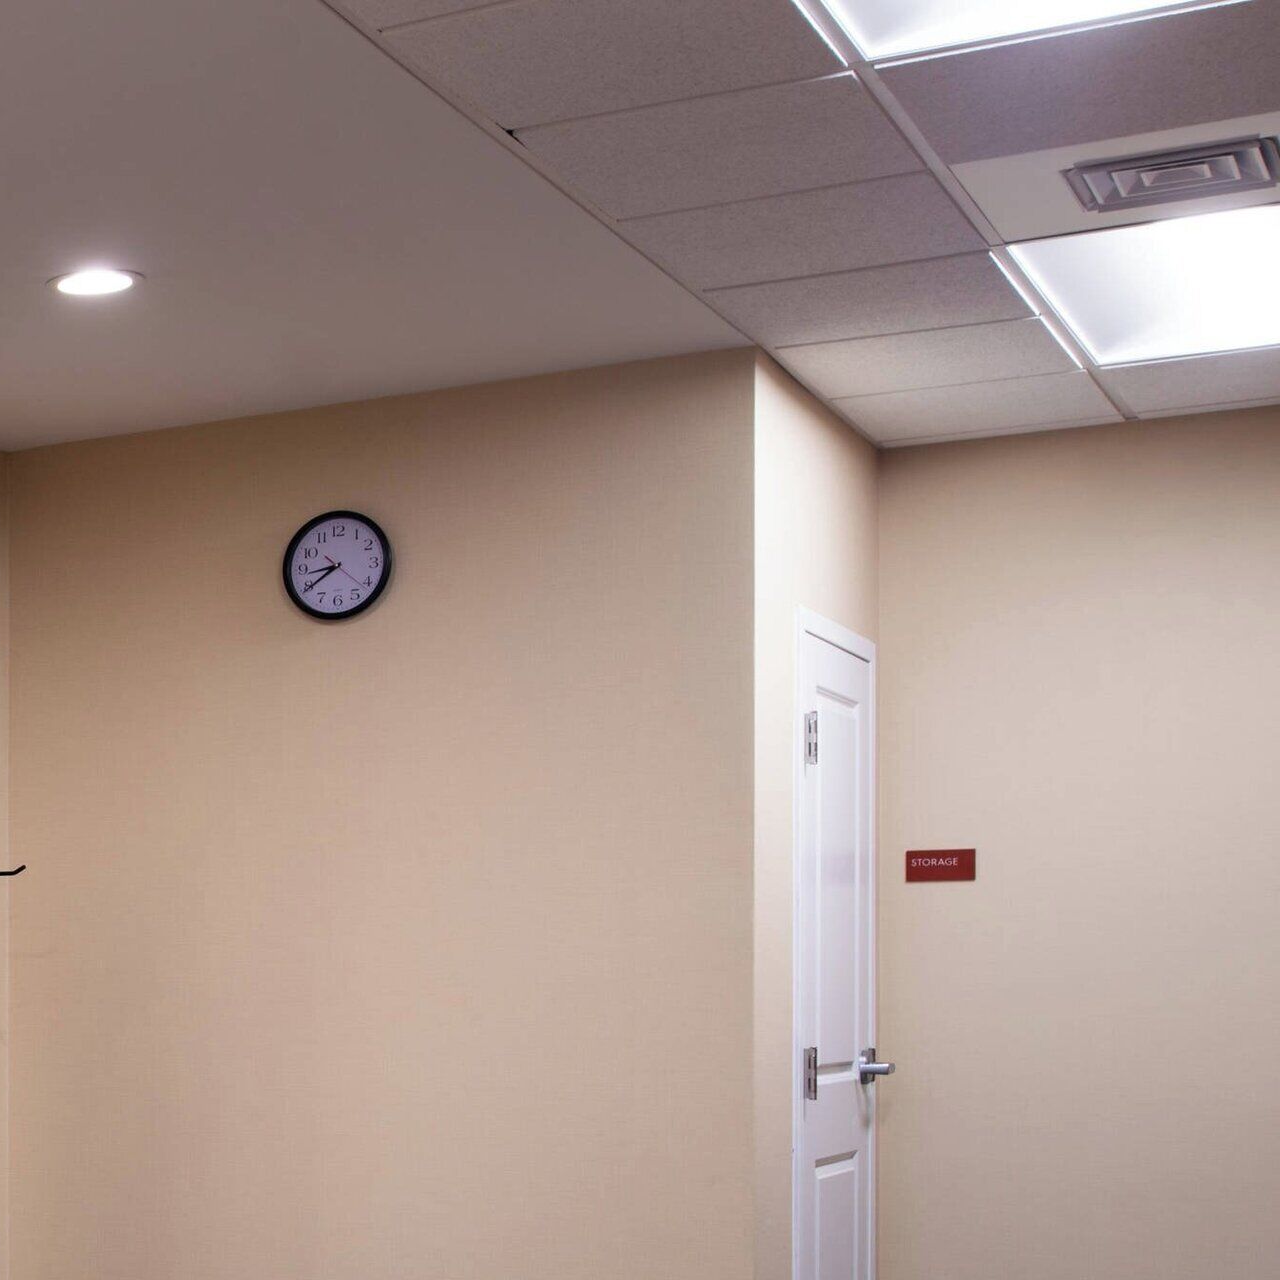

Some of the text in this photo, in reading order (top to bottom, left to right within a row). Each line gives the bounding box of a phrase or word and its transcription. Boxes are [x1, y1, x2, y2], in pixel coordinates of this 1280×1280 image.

[332, 525, 345, 537] 12
[354, 529, 359, 540] 1
[317, 532, 326, 544] 11
[363, 539, 373, 551] 2
[304, 547, 318, 559] 10
[369, 557, 379, 569] 3
[298, 564, 308, 576] 9
[362, 576, 372, 587] 4
[317, 592, 326, 604] 7
[333, 595, 343, 607] 6
[350, 589, 360, 601] 5
[911, 857, 958, 867] STORAGE
